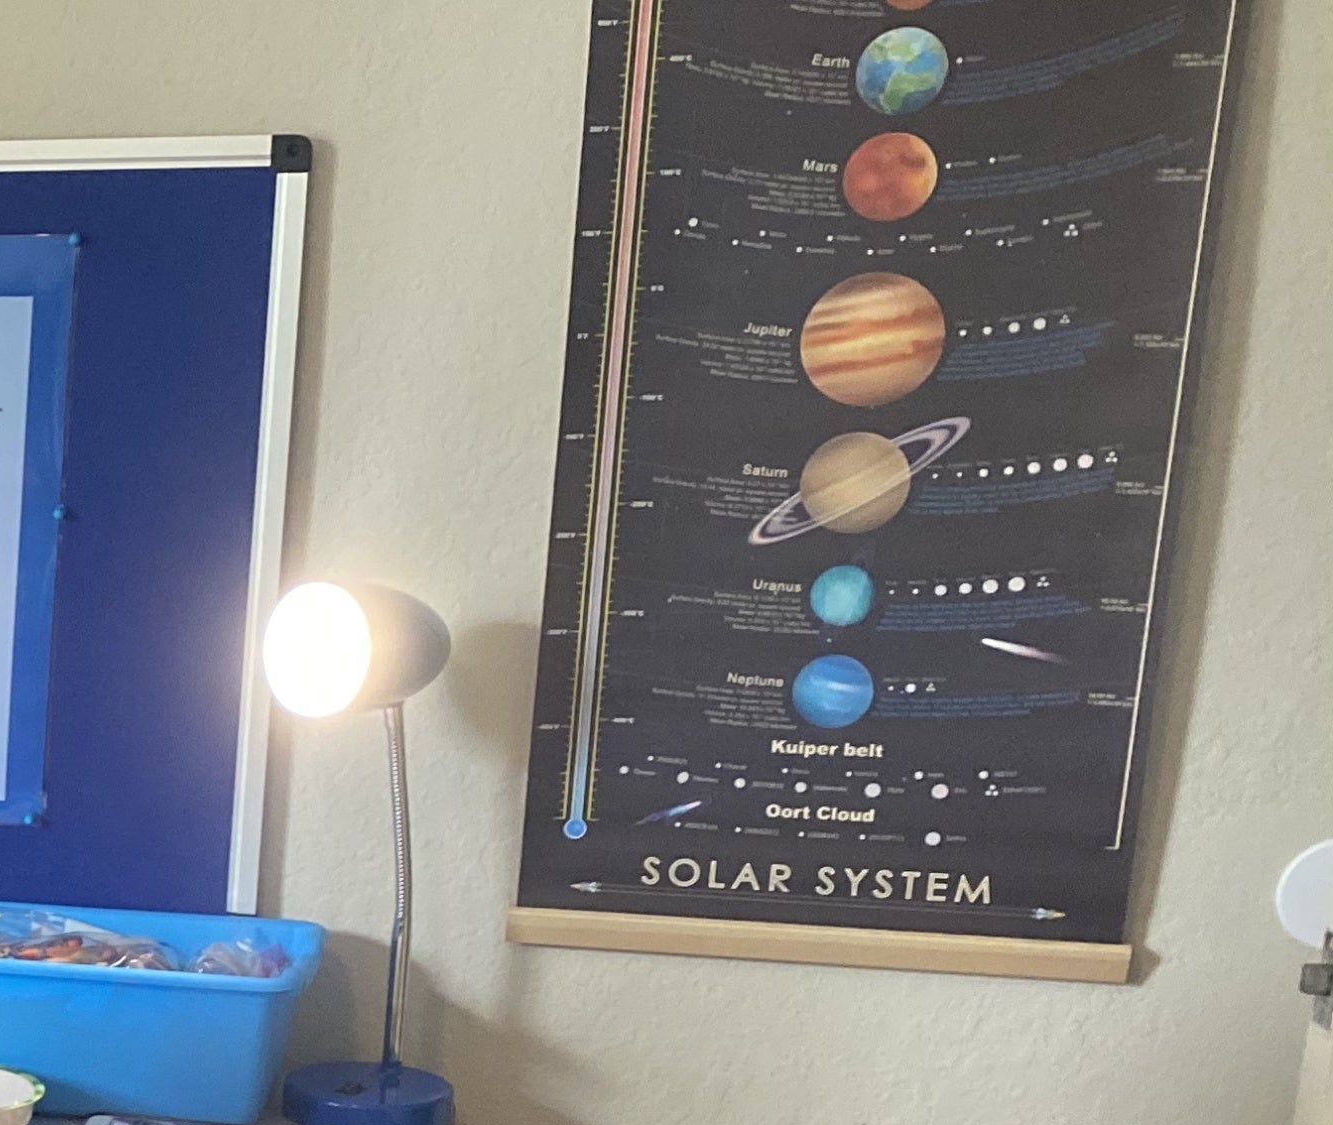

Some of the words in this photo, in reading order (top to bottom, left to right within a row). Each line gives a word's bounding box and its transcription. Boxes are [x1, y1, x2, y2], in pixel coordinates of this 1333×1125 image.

[811, 53, 850, 68] Earth
[802, 158, 838, 173] Mars
[743, 321, 794, 338] Jupiter
[742, 463, 789, 479] Saturn
[752, 577, 803, 594] Uranus
[726, 671, 784, 688] Neptune
[770, 738, 838, 758] Kuiper
[843, 742, 884, 758] belt
[764, 803, 811, 820] Oort
[816, 805, 876, 823] Cloud
[640, 855, 792, 893] SOLAR
[814, 865, 991, 905] SYSTEM
